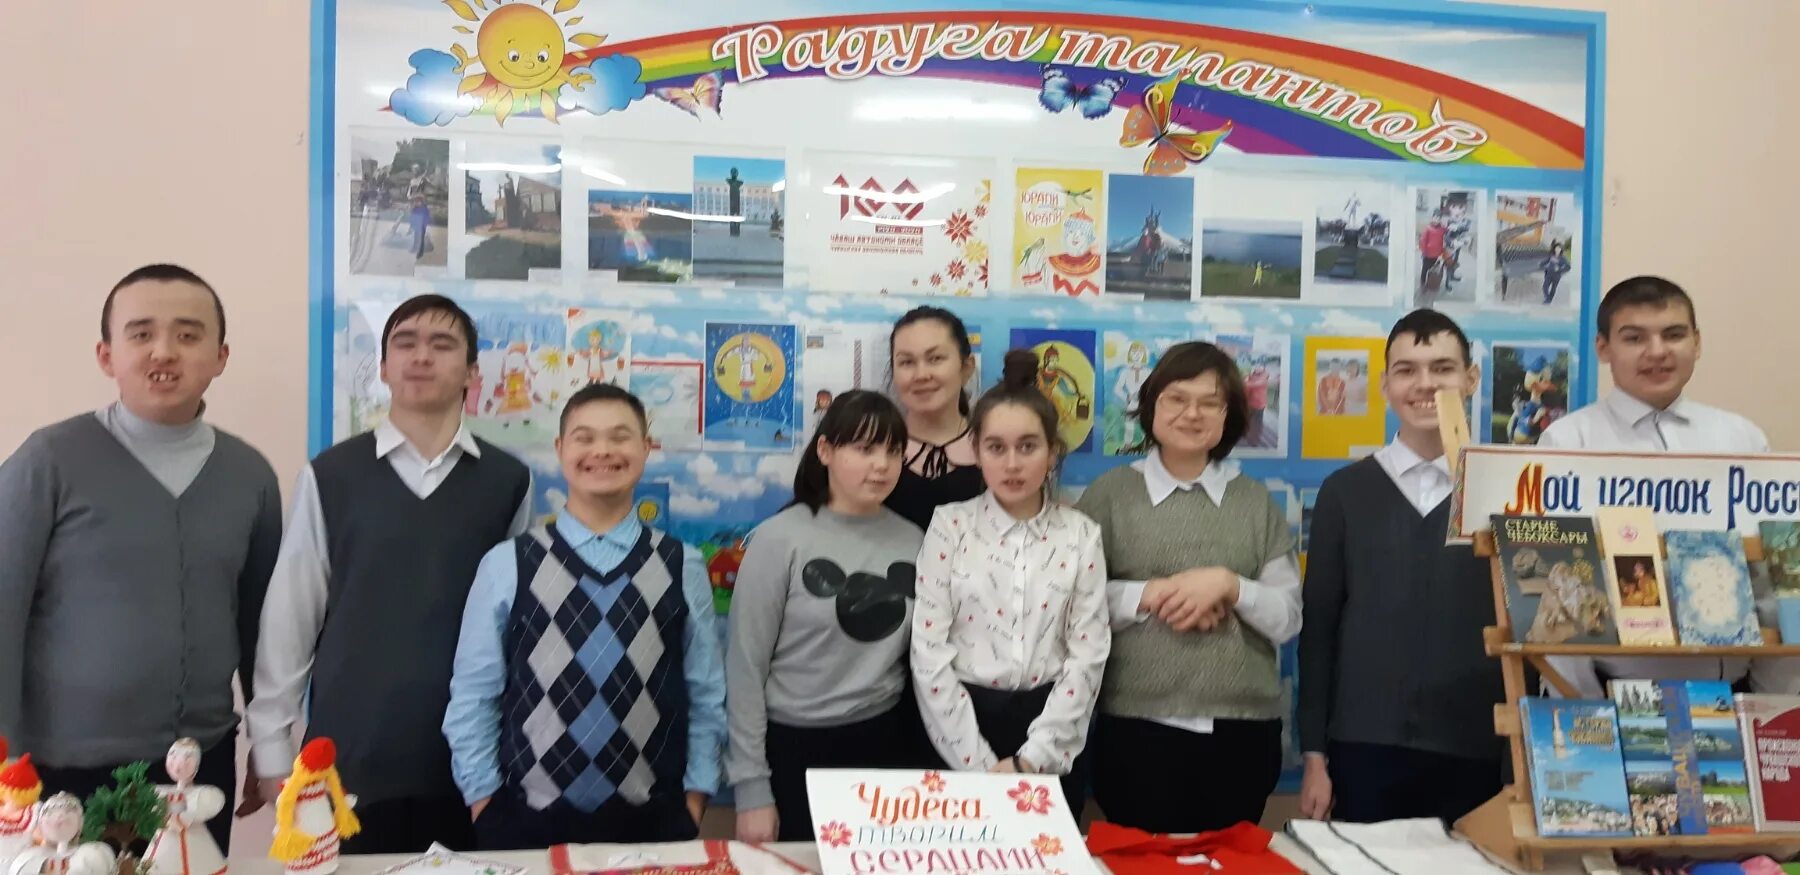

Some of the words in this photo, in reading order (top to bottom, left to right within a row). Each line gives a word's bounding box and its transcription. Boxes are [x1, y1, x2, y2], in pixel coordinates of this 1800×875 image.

[712, 20, 1051, 83] Радуга
[1052, 28, 1487, 163] талантов
[1504, 462, 1583, 516] Мой
[1727, 464, 1800, 531] Росс
[1505, 518, 1559, 532] СТАРЫЕ
[1507, 529, 1588, 544] ЧЕБОКСАРЫ
[850, 782, 992, 826] Чудеса
